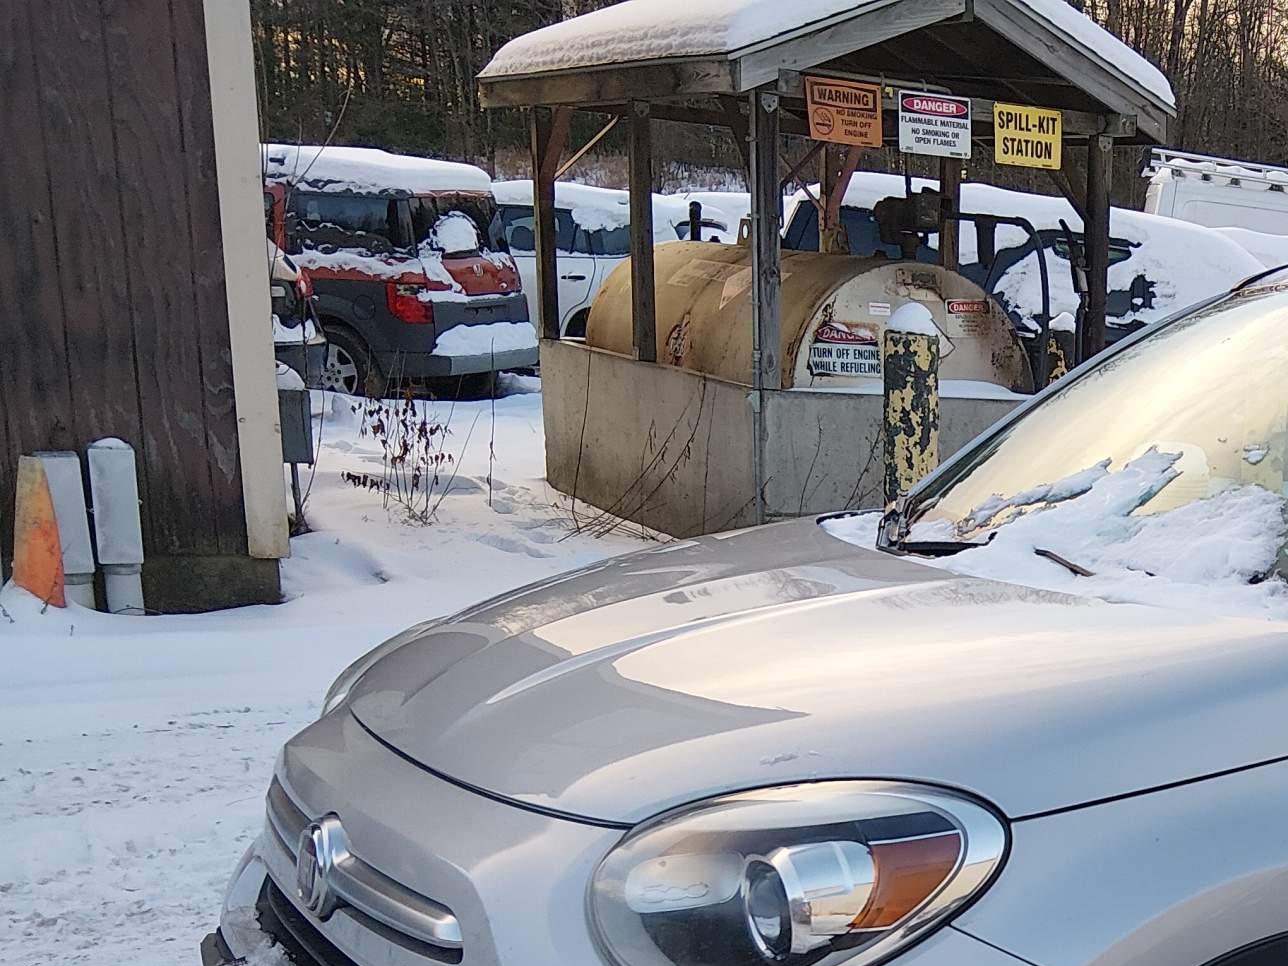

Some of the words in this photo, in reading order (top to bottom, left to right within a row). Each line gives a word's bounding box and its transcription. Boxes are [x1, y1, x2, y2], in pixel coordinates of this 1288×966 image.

[817, 87, 869, 106] WARNING
[913, 99, 957, 114] DANGER
[847, 110, 877, 120] SMOKING
[841, 119, 858, 127] TURN
[901, 115, 938, 126] FLAMMABLE
[940, 120, 969, 130] MATERIAL
[998, 110, 1058, 135] SPILL-KIT
[844, 129, 869, 138] ENGINE
[911, 127, 920, 135] NO
[922, 129, 950, 138] SMOKING
[915, 136, 931, 144] OPEN
[933, 138, 957, 147] FLAMES
[1002, 136, 1053, 160] STATION
[812, 347, 833, 359] TURN
[836, 348, 850, 360] OFF
[853, 349, 881, 361] ENGINE
[812, 360, 837, 372] WHILE
[841, 362, 881, 374] REFUELING
